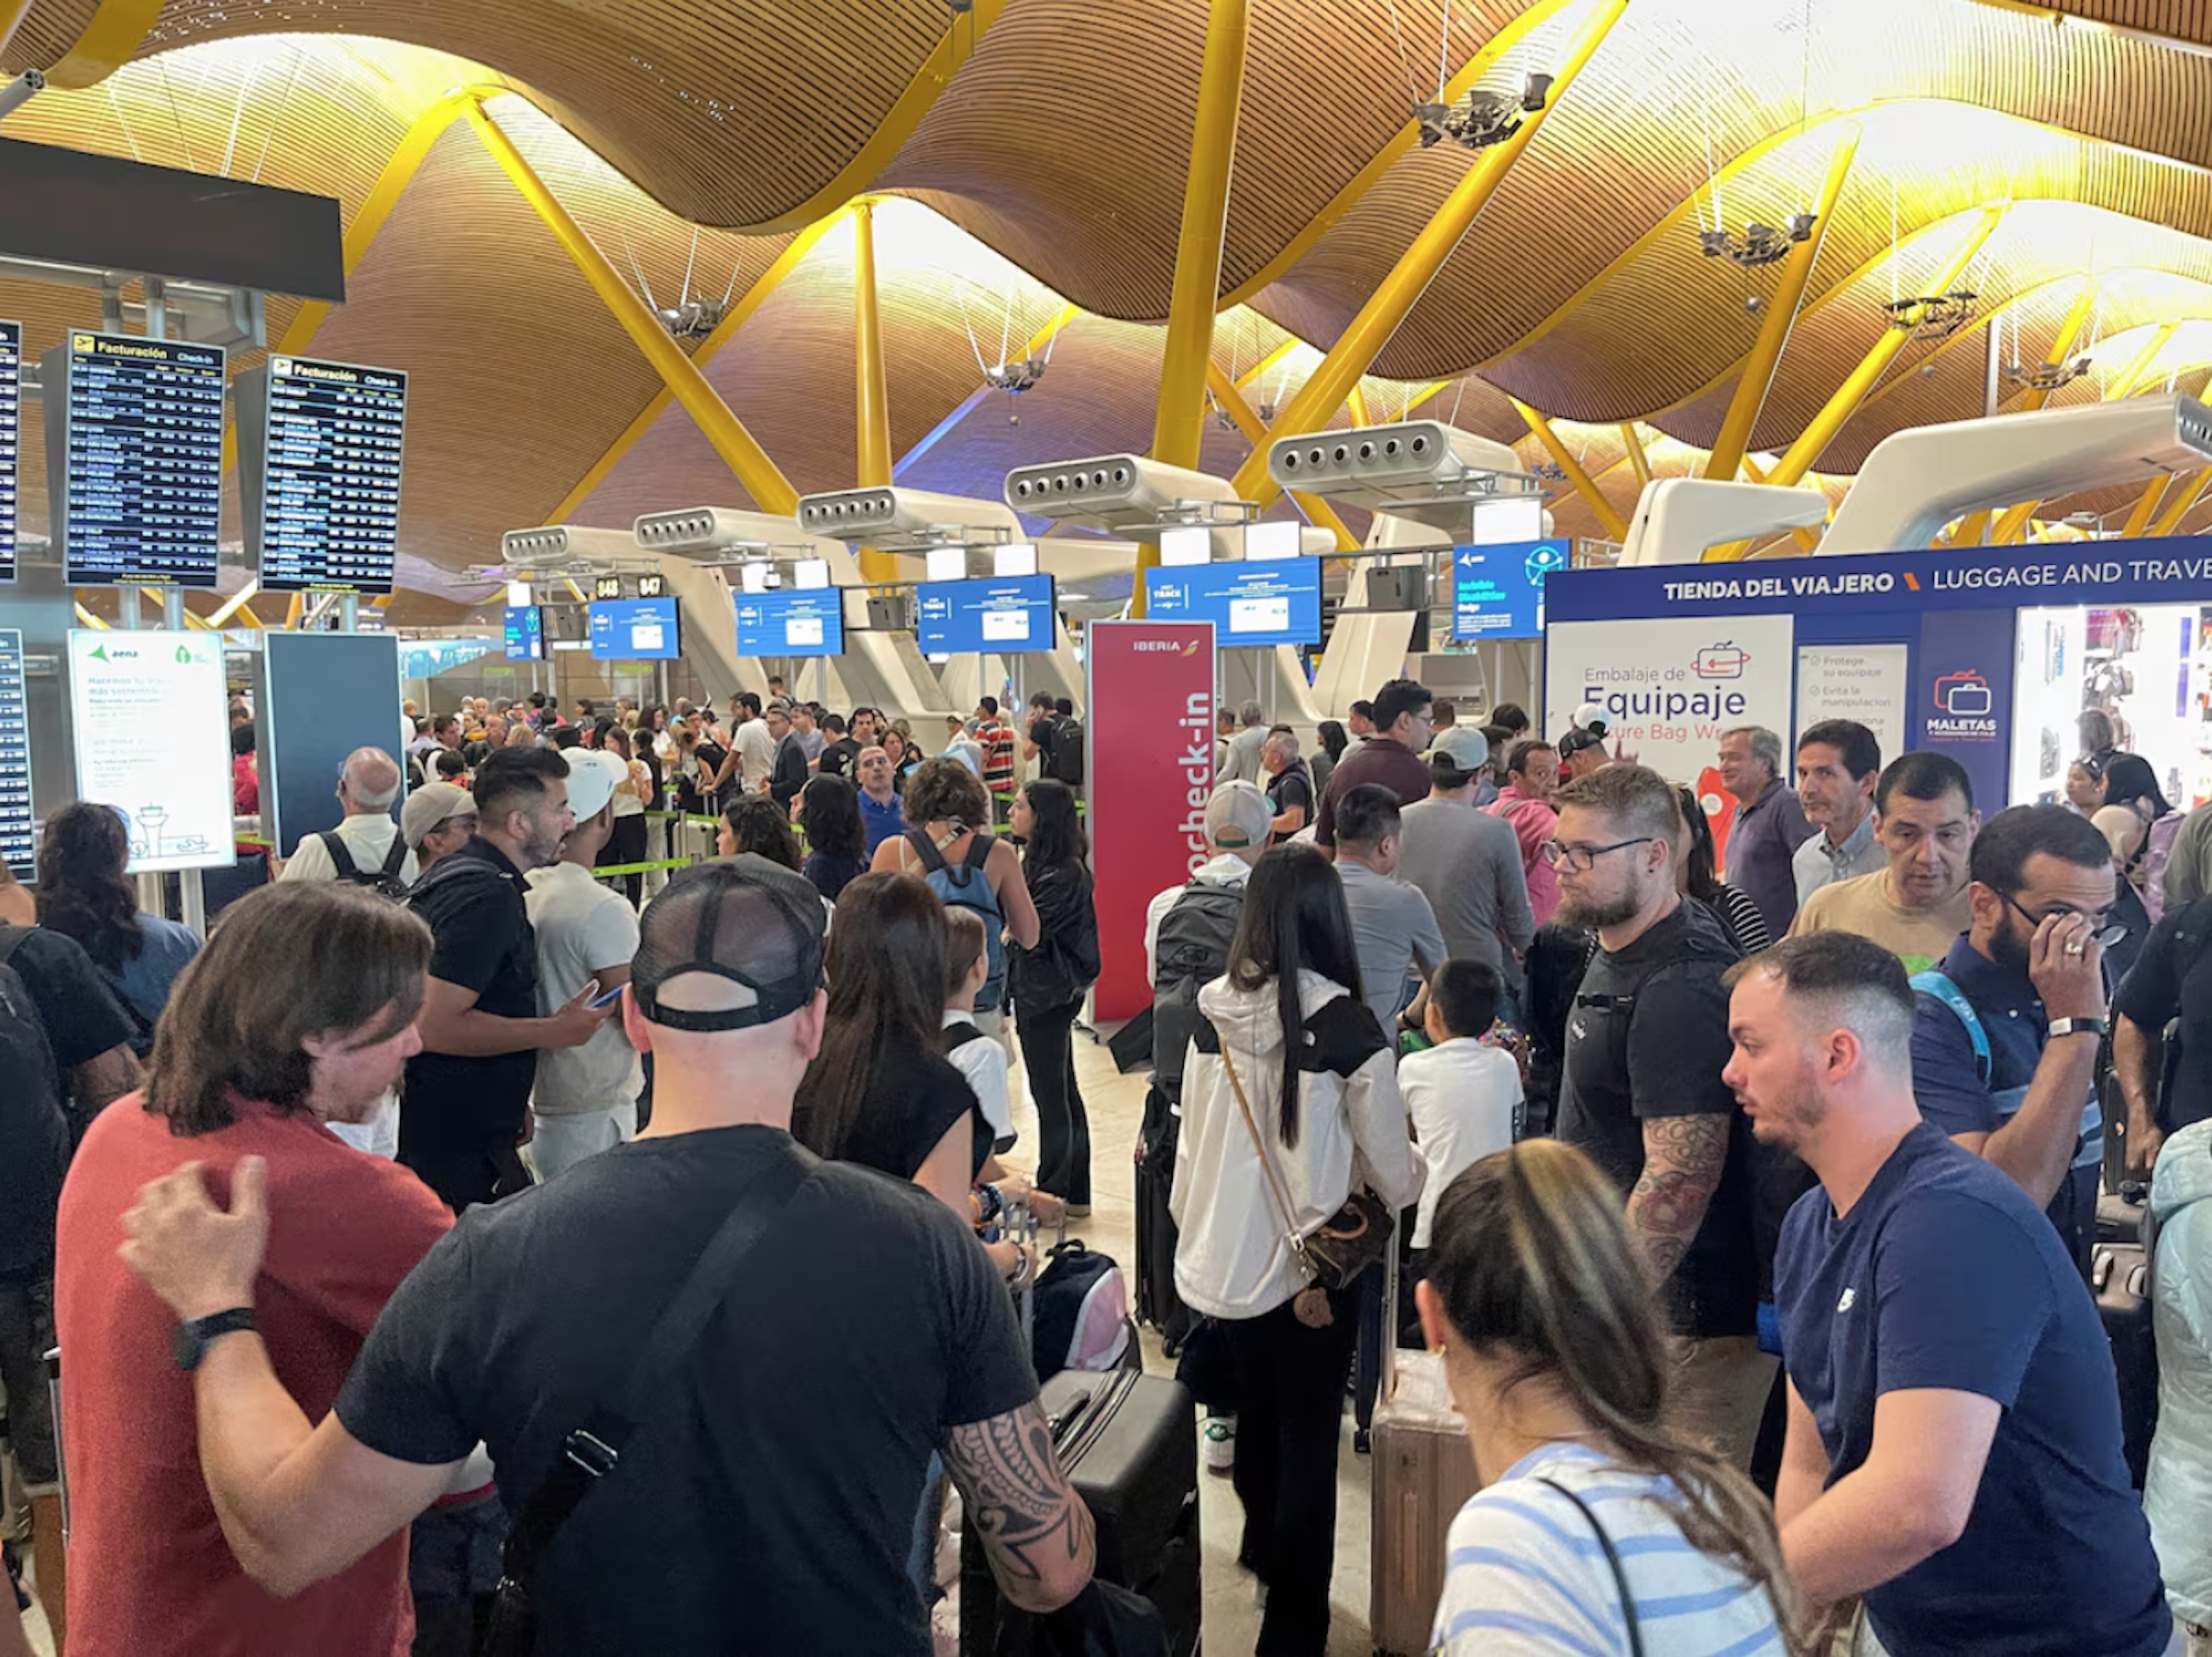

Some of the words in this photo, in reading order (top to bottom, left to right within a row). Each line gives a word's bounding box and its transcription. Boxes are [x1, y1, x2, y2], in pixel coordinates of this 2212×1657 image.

[98, 341, 167, 359] Facturación
[177, 352, 215, 365] Check-in
[293, 364, 358, 382] Facturación
[1933, 565, 2057, 590] LUGGAGE
[2062, 562, 2123, 584] AND
[2129, 558, 2212, 581] TRAVE
[1663, 580, 1742, 600] TIENDA
[1745, 578, 1787, 597] DEL
[1792, 573, 1896, 595] VIAJERO
[112, 649, 139, 658] aena
[1133, 641, 1181, 651] IBERIA
[1823, 657, 1865, 667] Protege
[1585, 667, 1659, 683] Embalaje
[1664, 667, 1686, 681] de
[1837, 668, 1883, 678] equipaje
[1823, 686, 1849, 695] Evita
[1585, 685, 1746, 721] Equipaje
[1606, 725, 1644, 740] cure
[1650, 724, 1687, 742] Bag
[1927, 719, 1996, 731] MALETAS
[1178, 693, 1209, 882] ocheck-in
